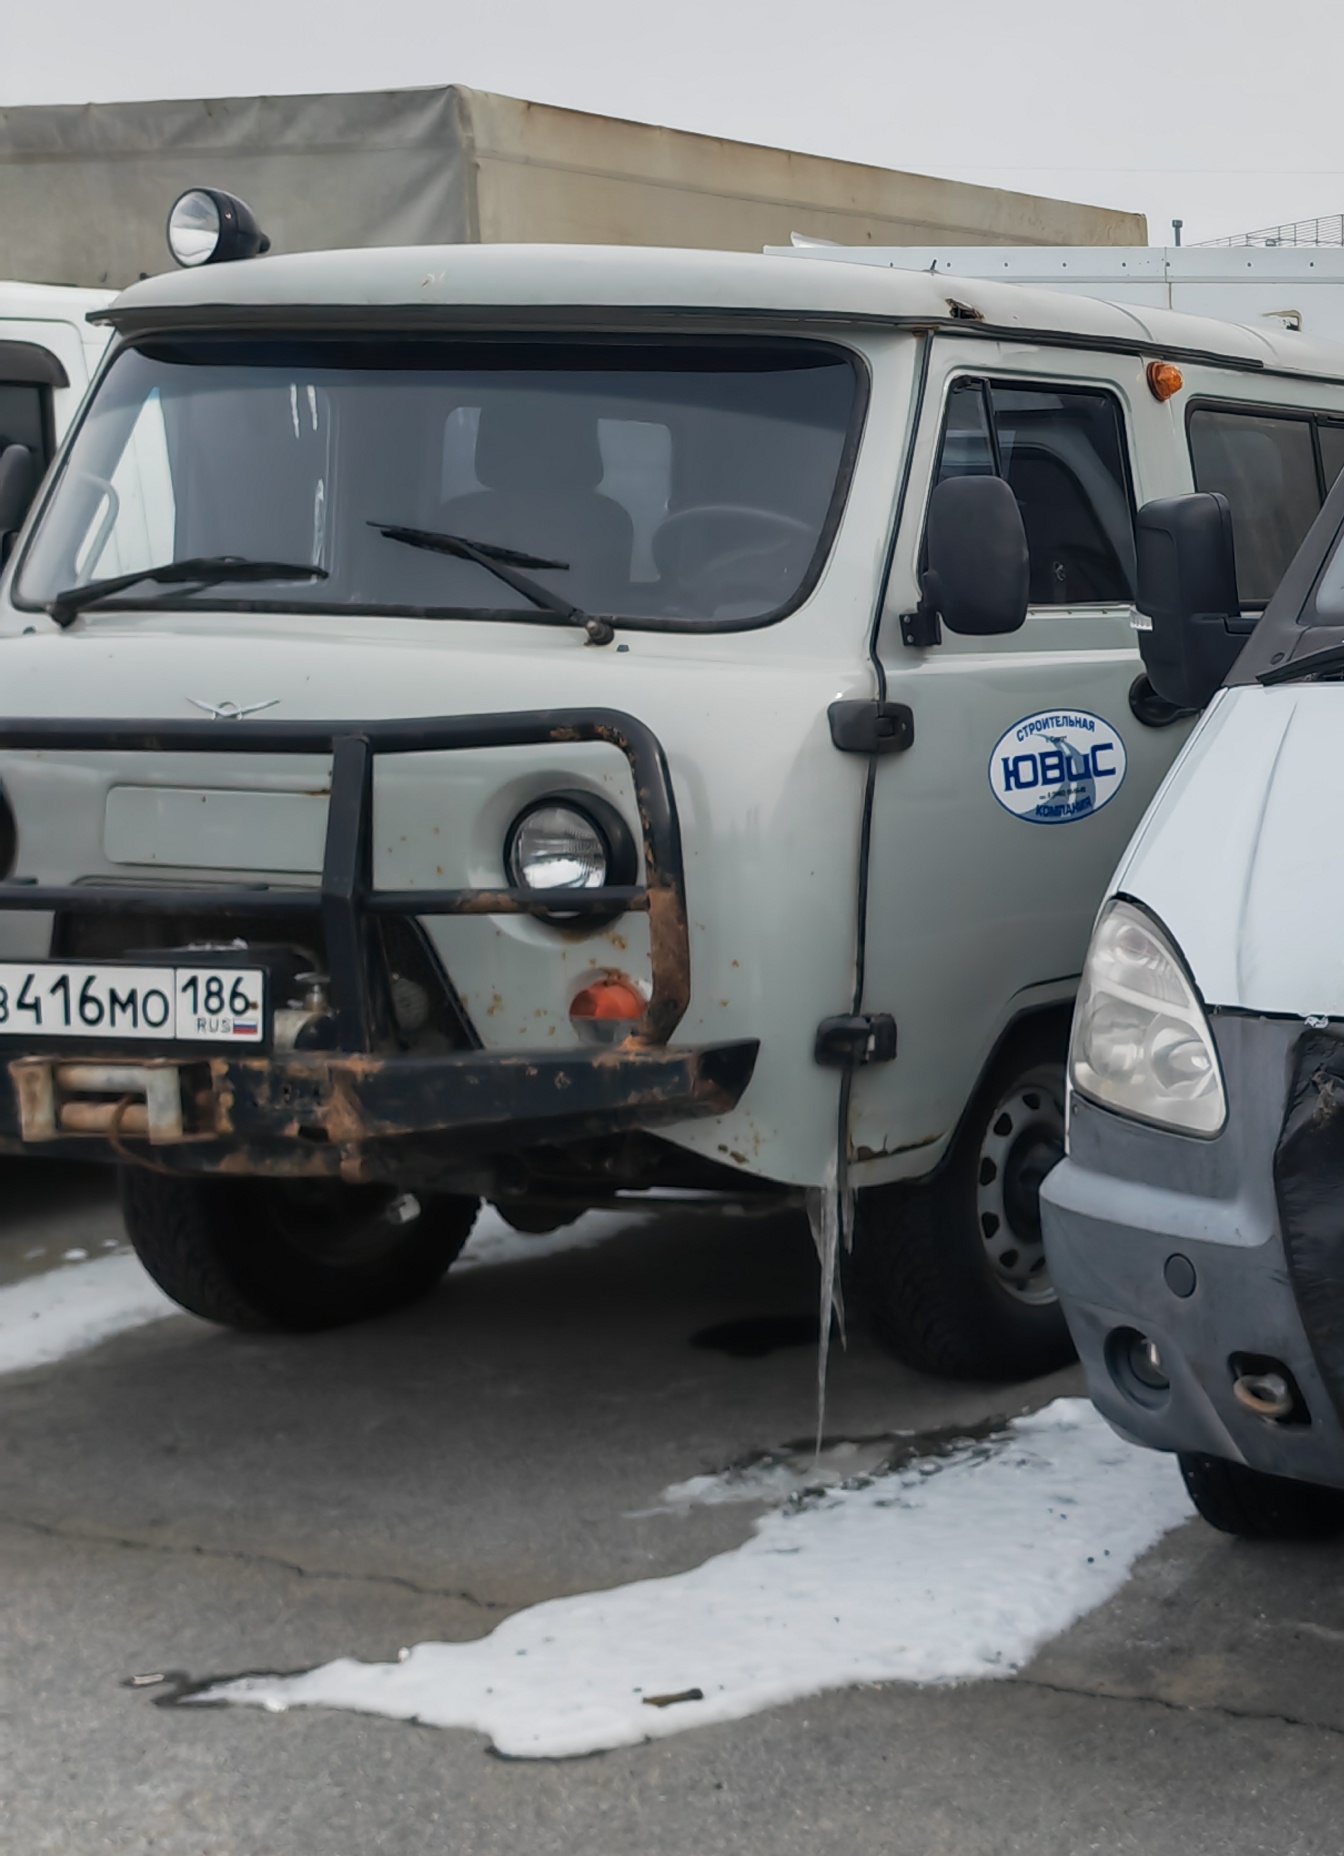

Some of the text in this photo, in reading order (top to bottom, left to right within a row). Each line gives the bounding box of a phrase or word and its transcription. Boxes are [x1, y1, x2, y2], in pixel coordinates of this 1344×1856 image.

[1016, 715, 1096, 742] СТРОИТЕЛЬНАЯ
[181, 975, 251, 1016] 186
[196, 1017, 232, 1034] RUS
